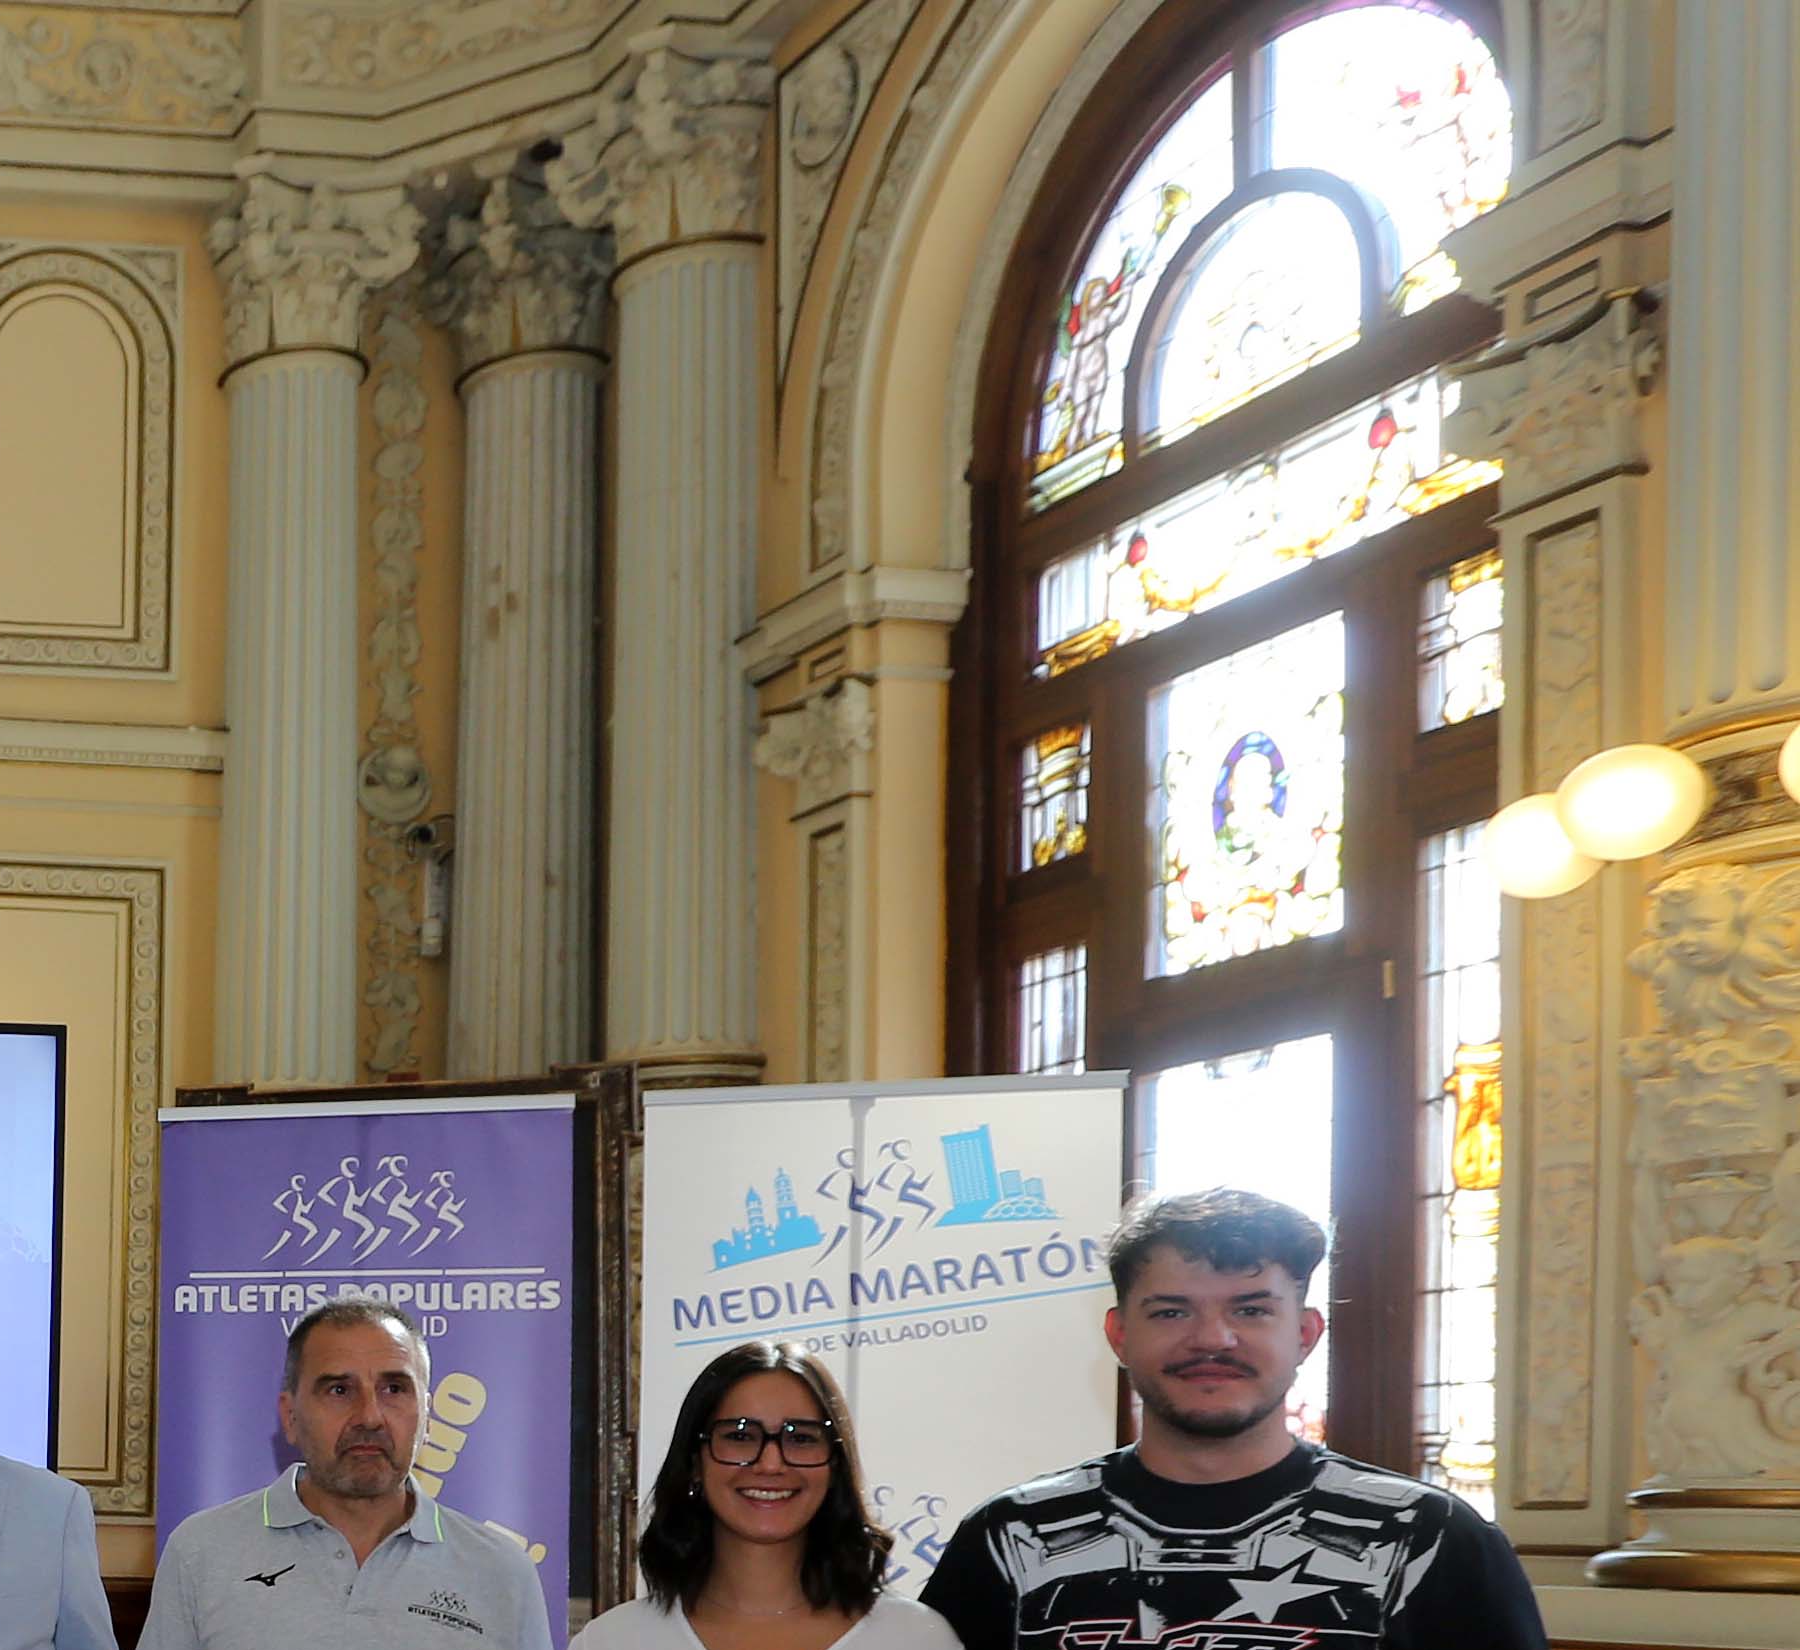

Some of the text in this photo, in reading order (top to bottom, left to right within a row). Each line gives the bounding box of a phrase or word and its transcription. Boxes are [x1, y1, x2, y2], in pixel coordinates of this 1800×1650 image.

[174, 1283, 327, 1313] ATLETAS
[673, 1278, 835, 1331] MEDIA
[843, 1314, 987, 1349] VALLADOLID
